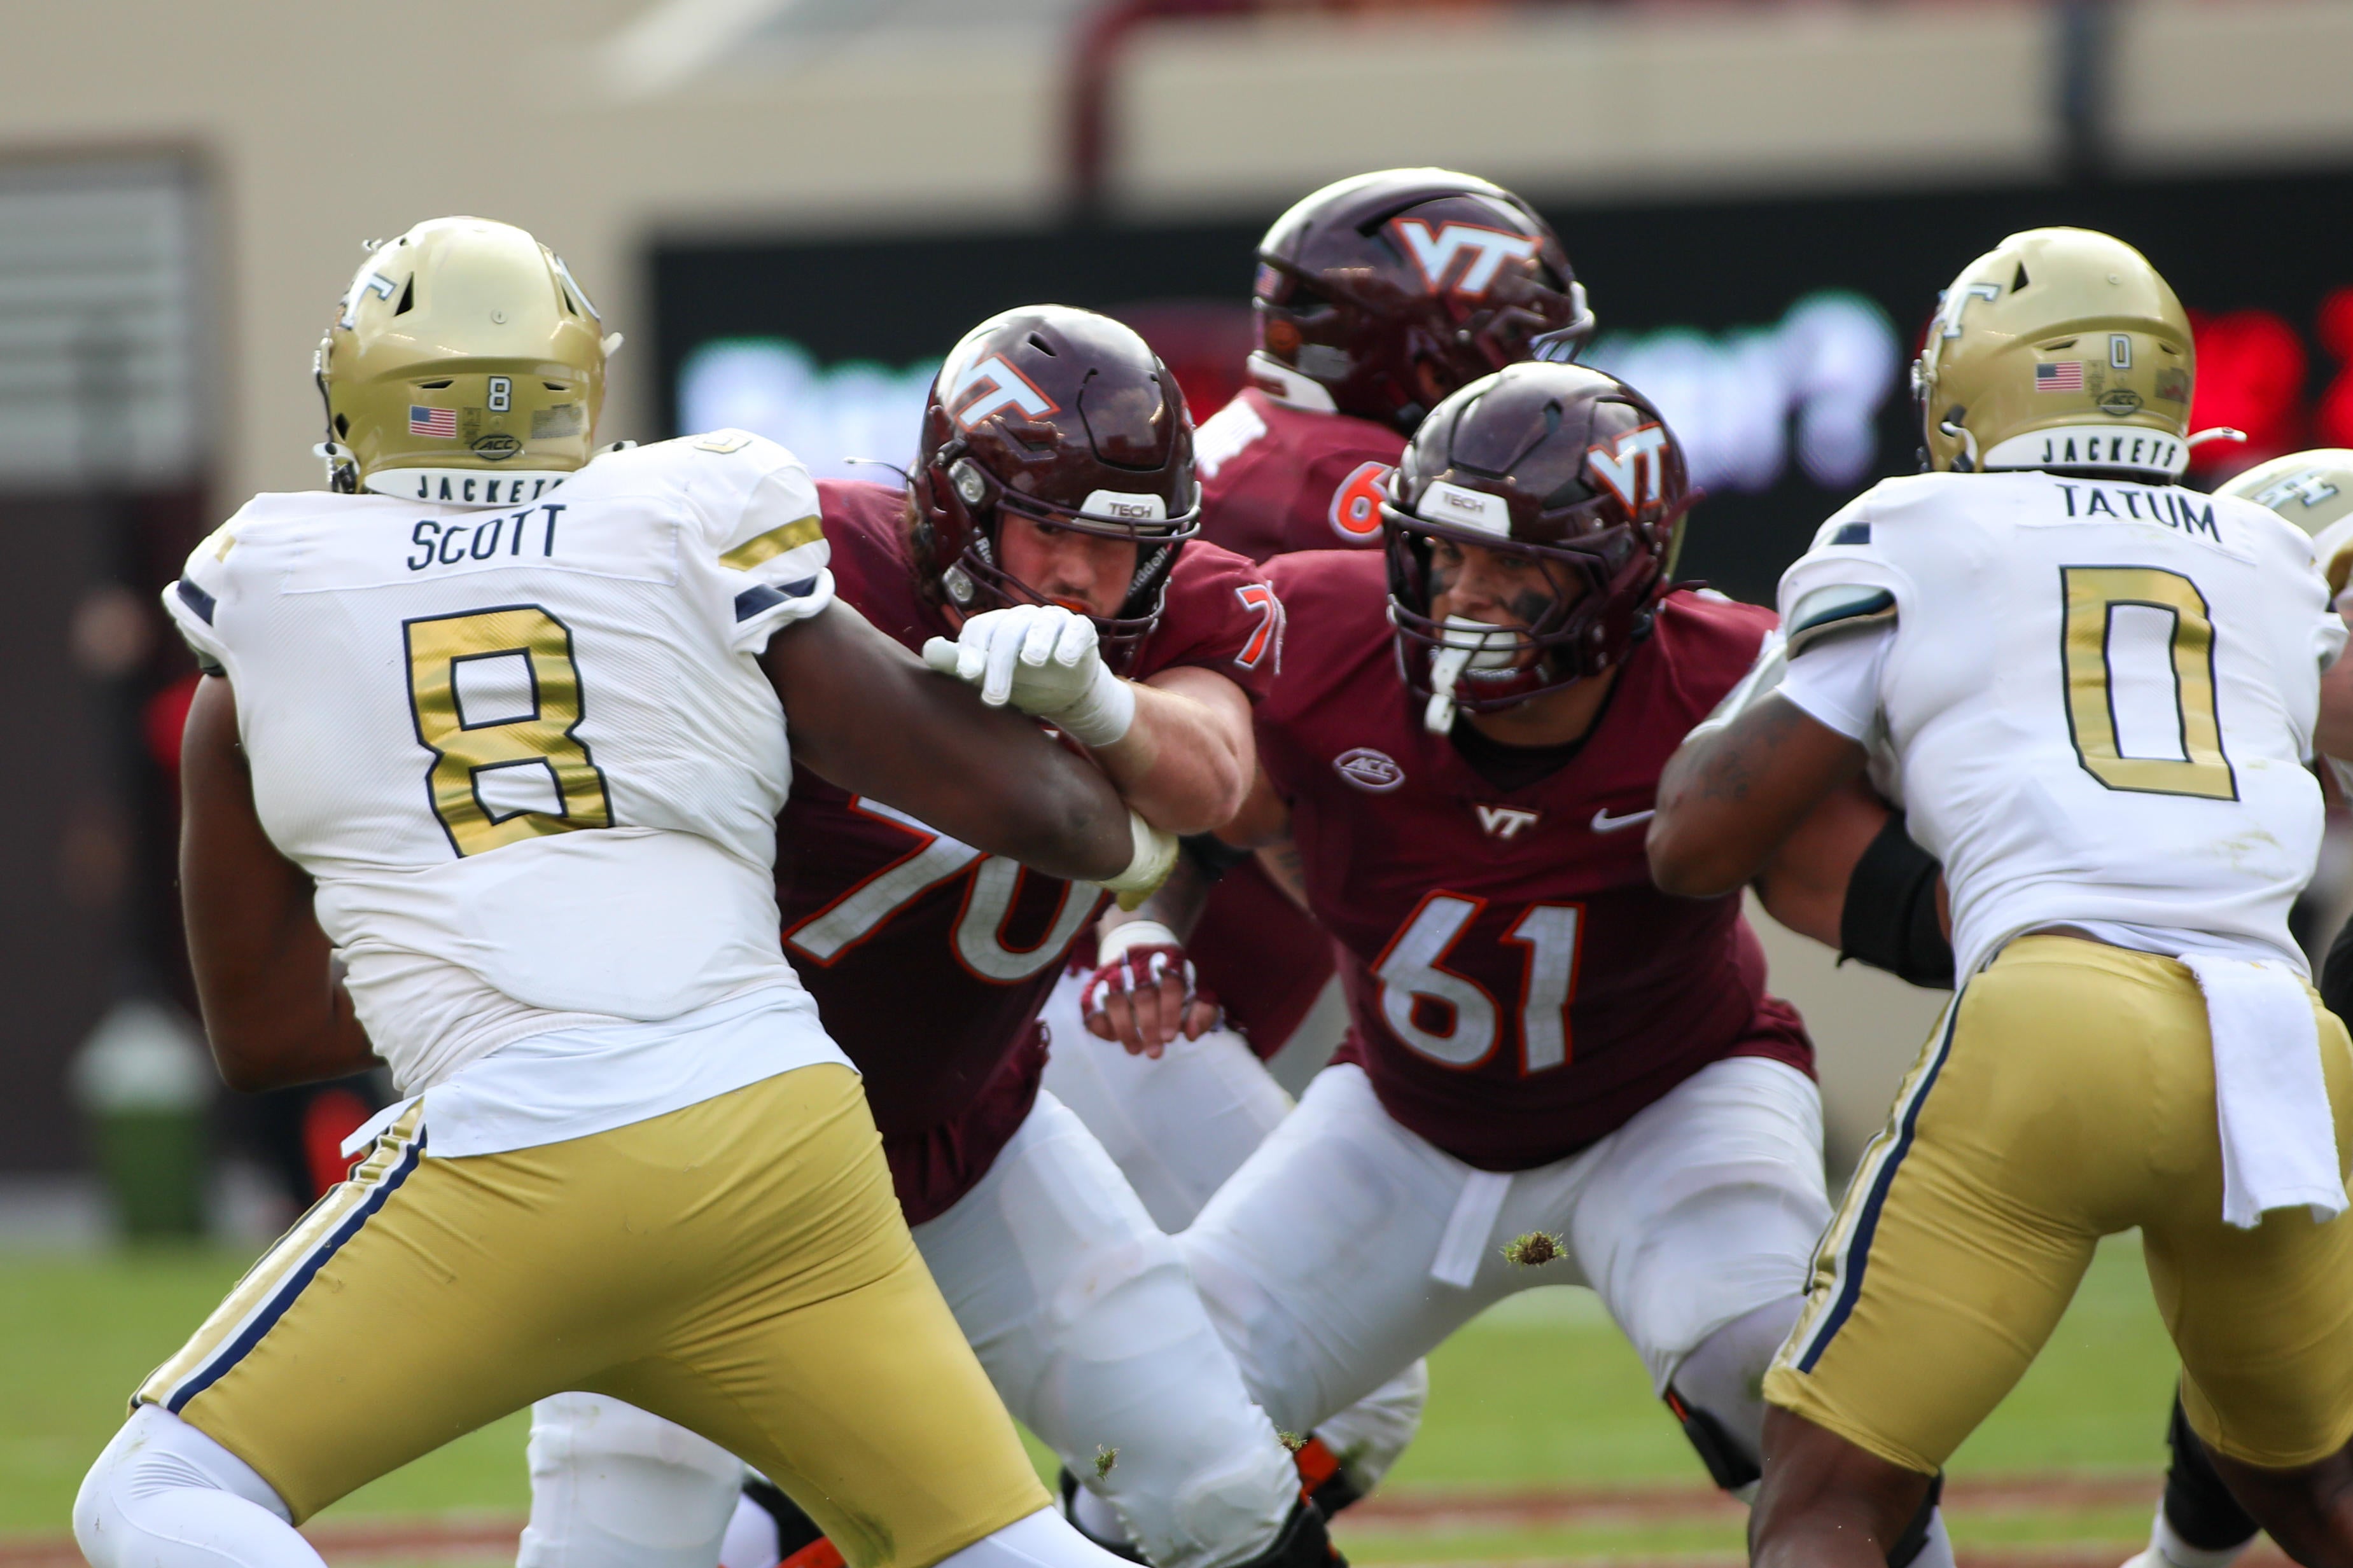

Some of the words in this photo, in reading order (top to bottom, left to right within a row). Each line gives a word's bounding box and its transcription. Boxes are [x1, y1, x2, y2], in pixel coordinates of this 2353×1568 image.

[1390, 218, 1544, 296] VT
[2109, 333, 2132, 369] 0
[488, 376, 512, 412] 8
[477, 439, 515, 451] ACC
[1588, 420, 1670, 518] VT
[2042, 436, 2176, 468] JACKETS
[1108, 502, 1153, 518] TECH
[1442, 490, 1486, 513] TECH
[2055, 483, 2223, 544] TATUM
[408, 504, 567, 571] SCOTT
[2060, 564, 2240, 802] 0
[403, 604, 615, 859] 8
[1476, 803, 1540, 839] VT
[1369, 889, 1586, 1078] 61
